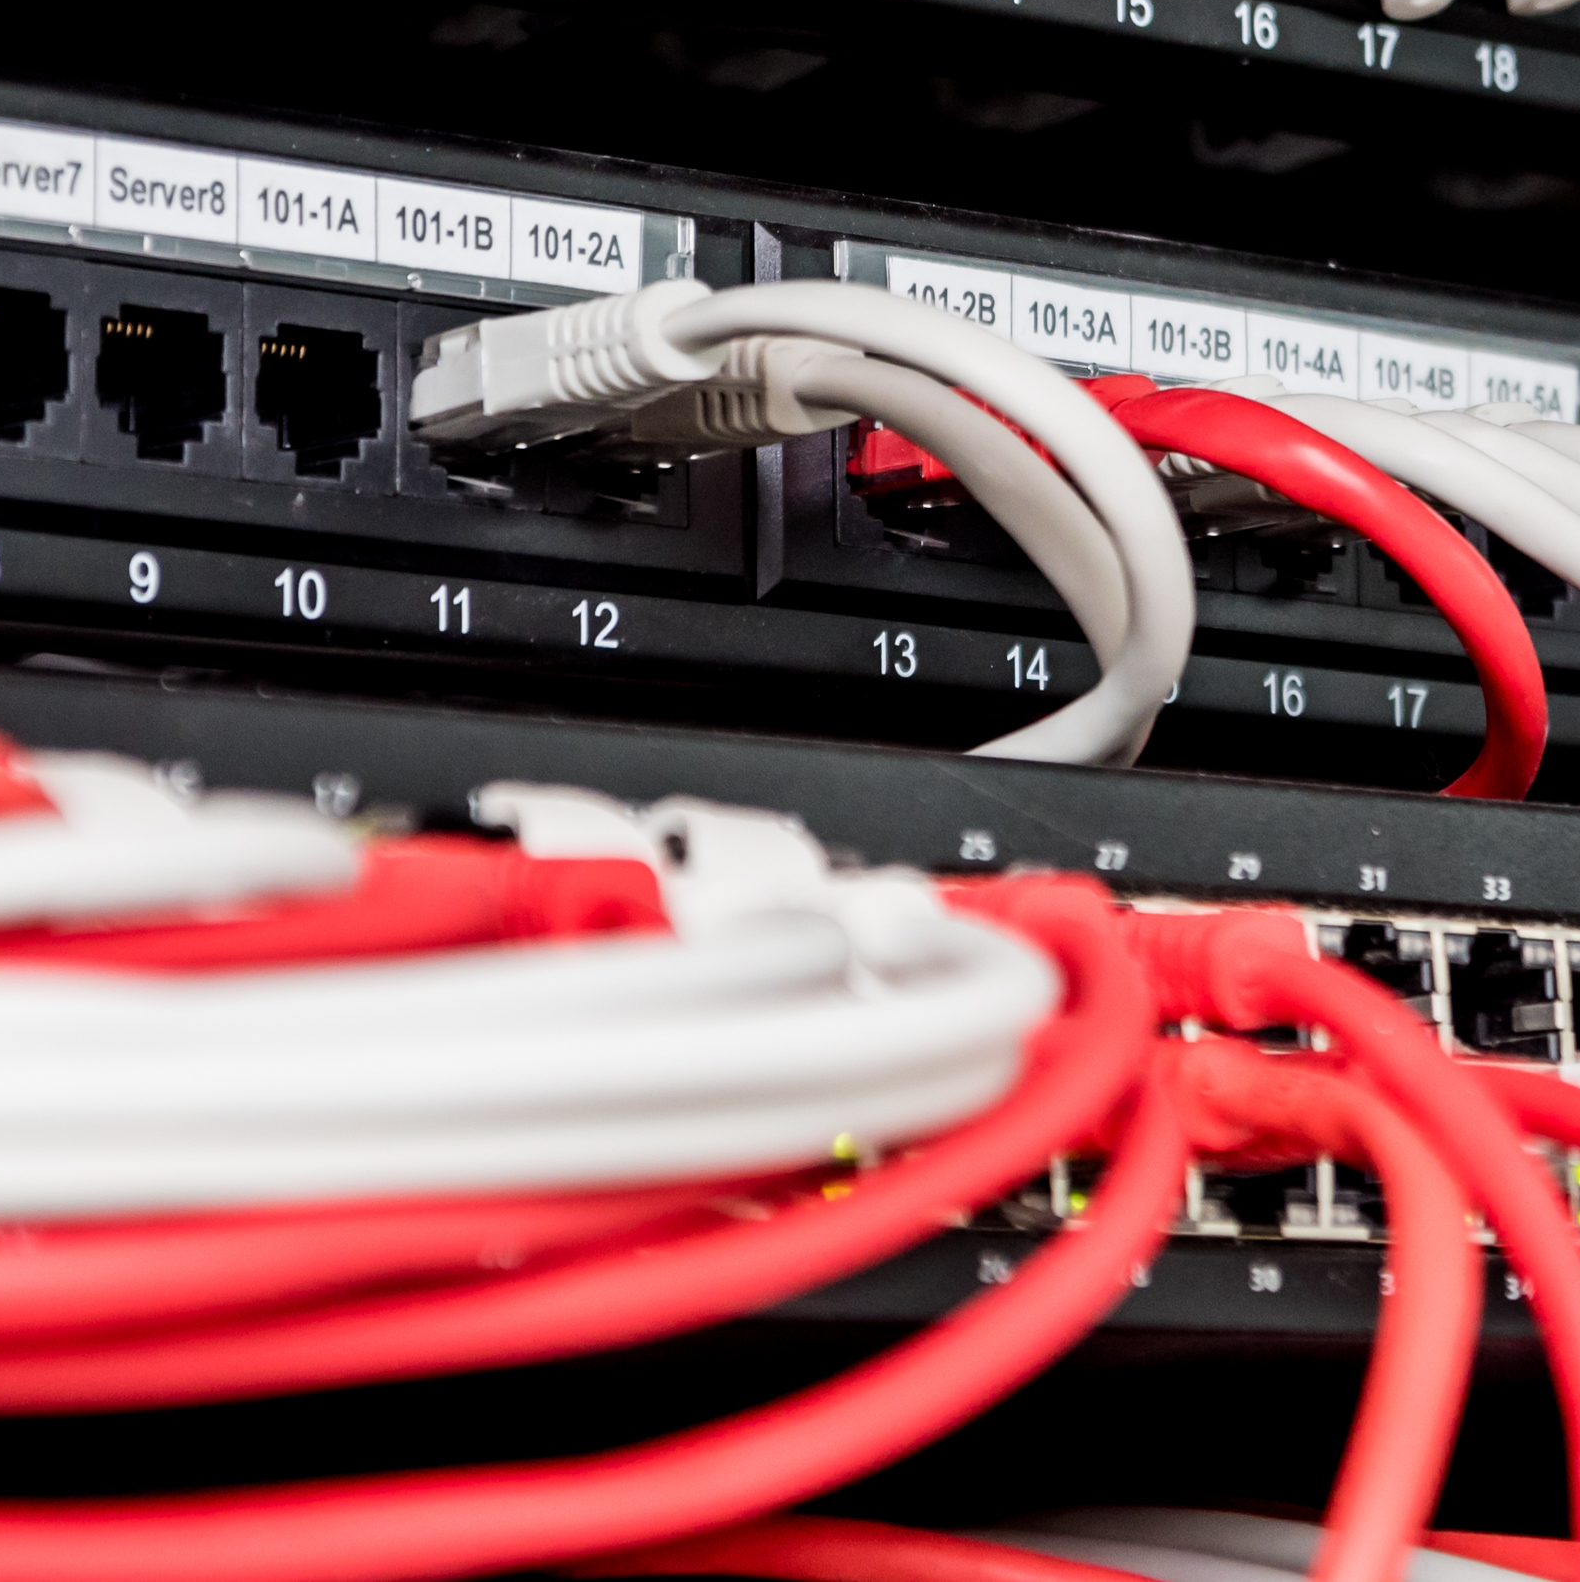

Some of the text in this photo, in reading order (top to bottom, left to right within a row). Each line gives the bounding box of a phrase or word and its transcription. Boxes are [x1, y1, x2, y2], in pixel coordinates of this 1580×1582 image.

[1234, 0, 1279, 50] 16
[1357, 24, 1400, 70] 17
[1474, 43, 1519, 93] 18
[109, 169, 227, 217] Server8
[256, 186, 360, 235] 101-1A
[395, 206, 495, 253] 101-1B
[529, 223, 625, 270] 101-2A
[1027, 300, 1117, 346] 101-3A
[1147, 319, 1232, 362] 101-3B
[1262, 338, 1345, 383] 101-4A
[1375, 357, 1455, 399] 101-4B
[128, 551, 160, 604] 9
[274, 567, 327, 620] 10
[430, 584, 471, 634] 11
[572, 599, 620, 649] 12
[873, 630, 918, 678] 13
[1006, 643, 1049, 691] 14
[1263, 670, 1306, 717] 16
[1387, 683, 1429, 729] 17
[1094, 842, 1129, 871] 27
[1228, 852, 1262, 881] 29
[1359, 864, 1387, 892] 31
[1482, 875, 1512, 902] 33
[1250, 1265, 1282, 1293] 30
